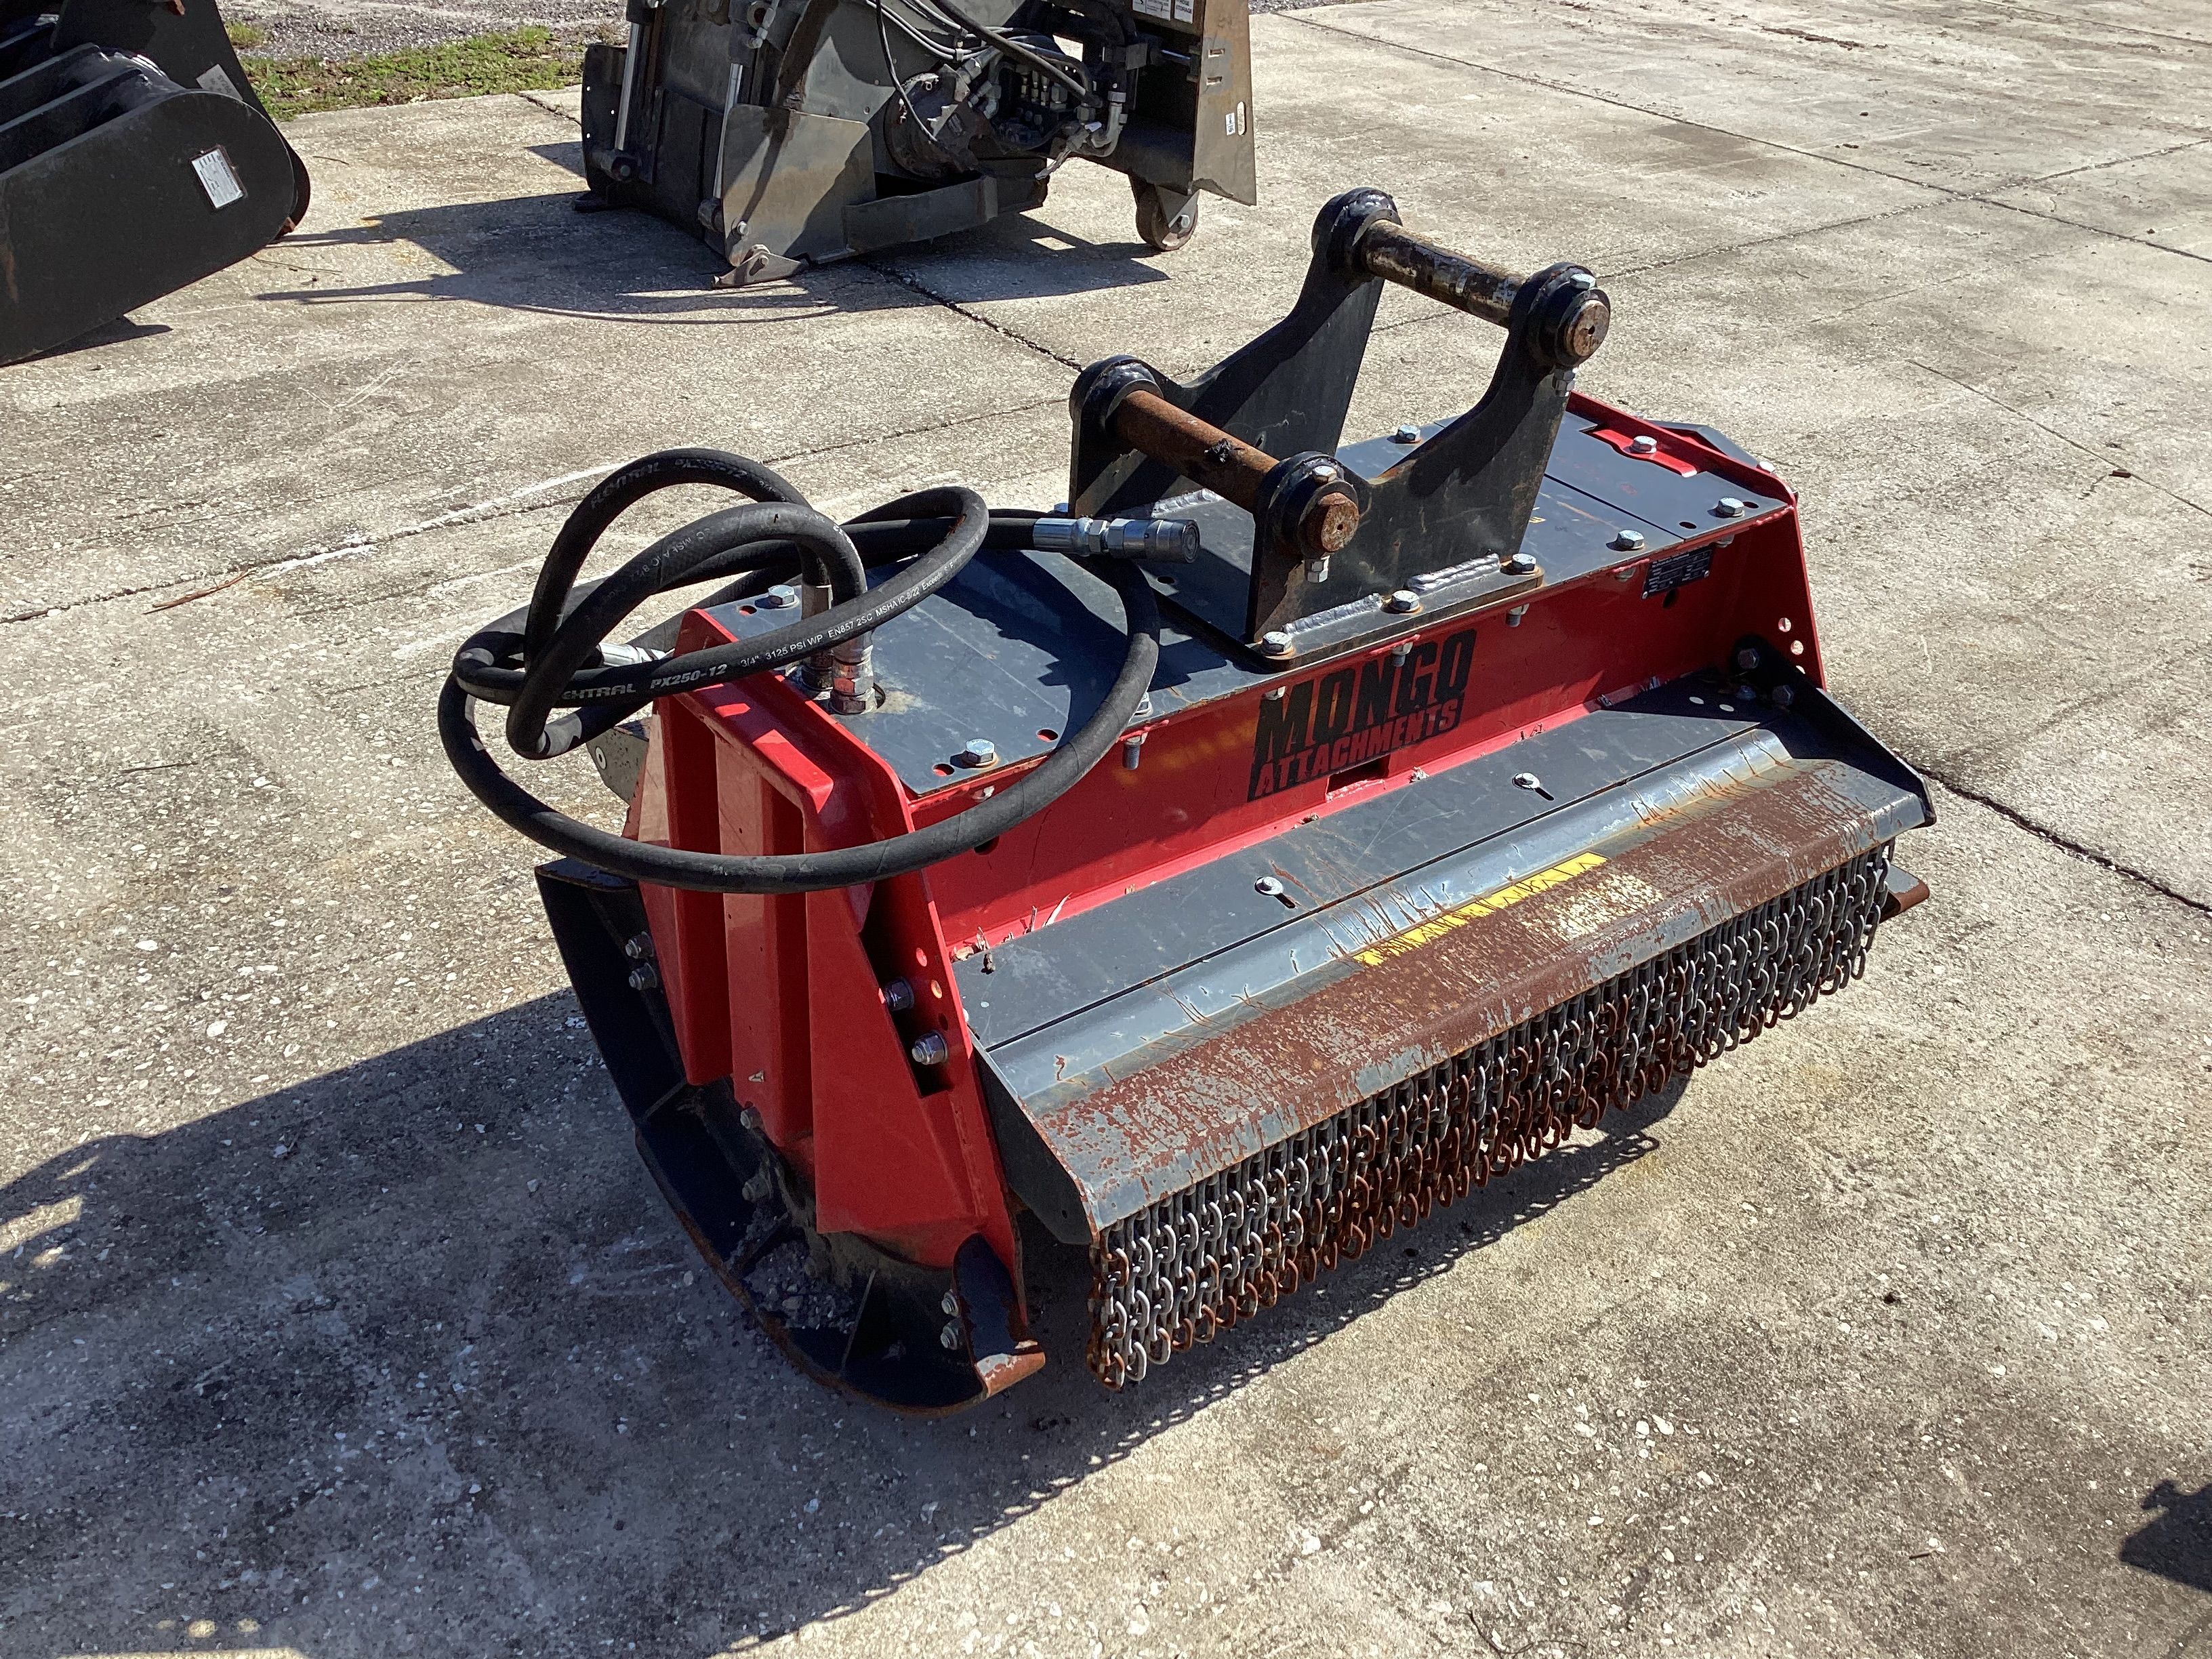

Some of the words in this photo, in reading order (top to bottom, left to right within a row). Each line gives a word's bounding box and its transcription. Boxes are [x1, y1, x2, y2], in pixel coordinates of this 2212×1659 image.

[649, 663, 728, 690] PX250-12
[765, 647, 789, 660] 3125
[790, 641, 806, 653] PSI
[806, 634, 823, 646] WP
[827, 621, 854, 638] EN857
[856, 613, 873, 627] 2SC
[875, 600, 898, 617] MSHA
[1253, 628, 1477, 766] MONGO
[1253, 698, 1459, 798] ATTACHMENTS
